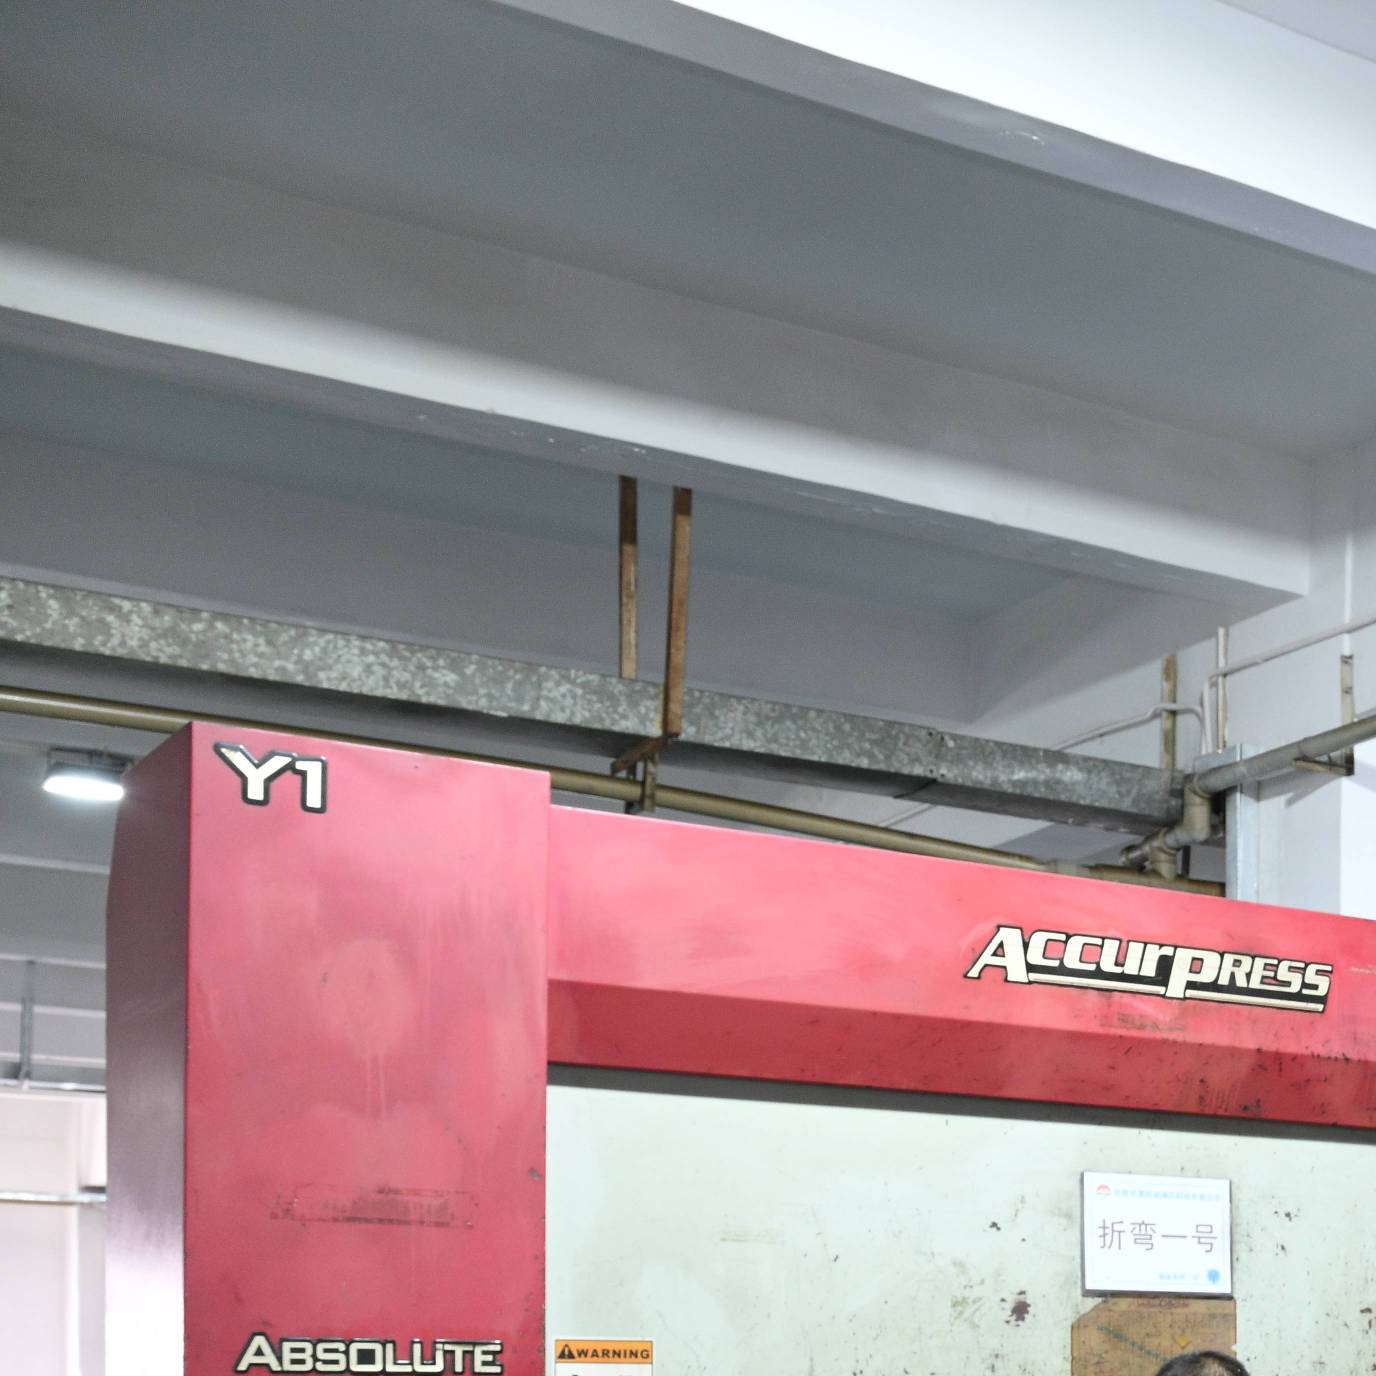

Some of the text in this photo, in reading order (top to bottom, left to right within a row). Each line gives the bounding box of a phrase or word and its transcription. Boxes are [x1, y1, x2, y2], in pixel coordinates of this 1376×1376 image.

[215, 744, 325, 811] Y1
[1098, 1219, 1218, 1253] 折弯一号
[236, 1333, 502, 1374] ABSOLUTE
[576, 1349, 650, 1359] WARNING
